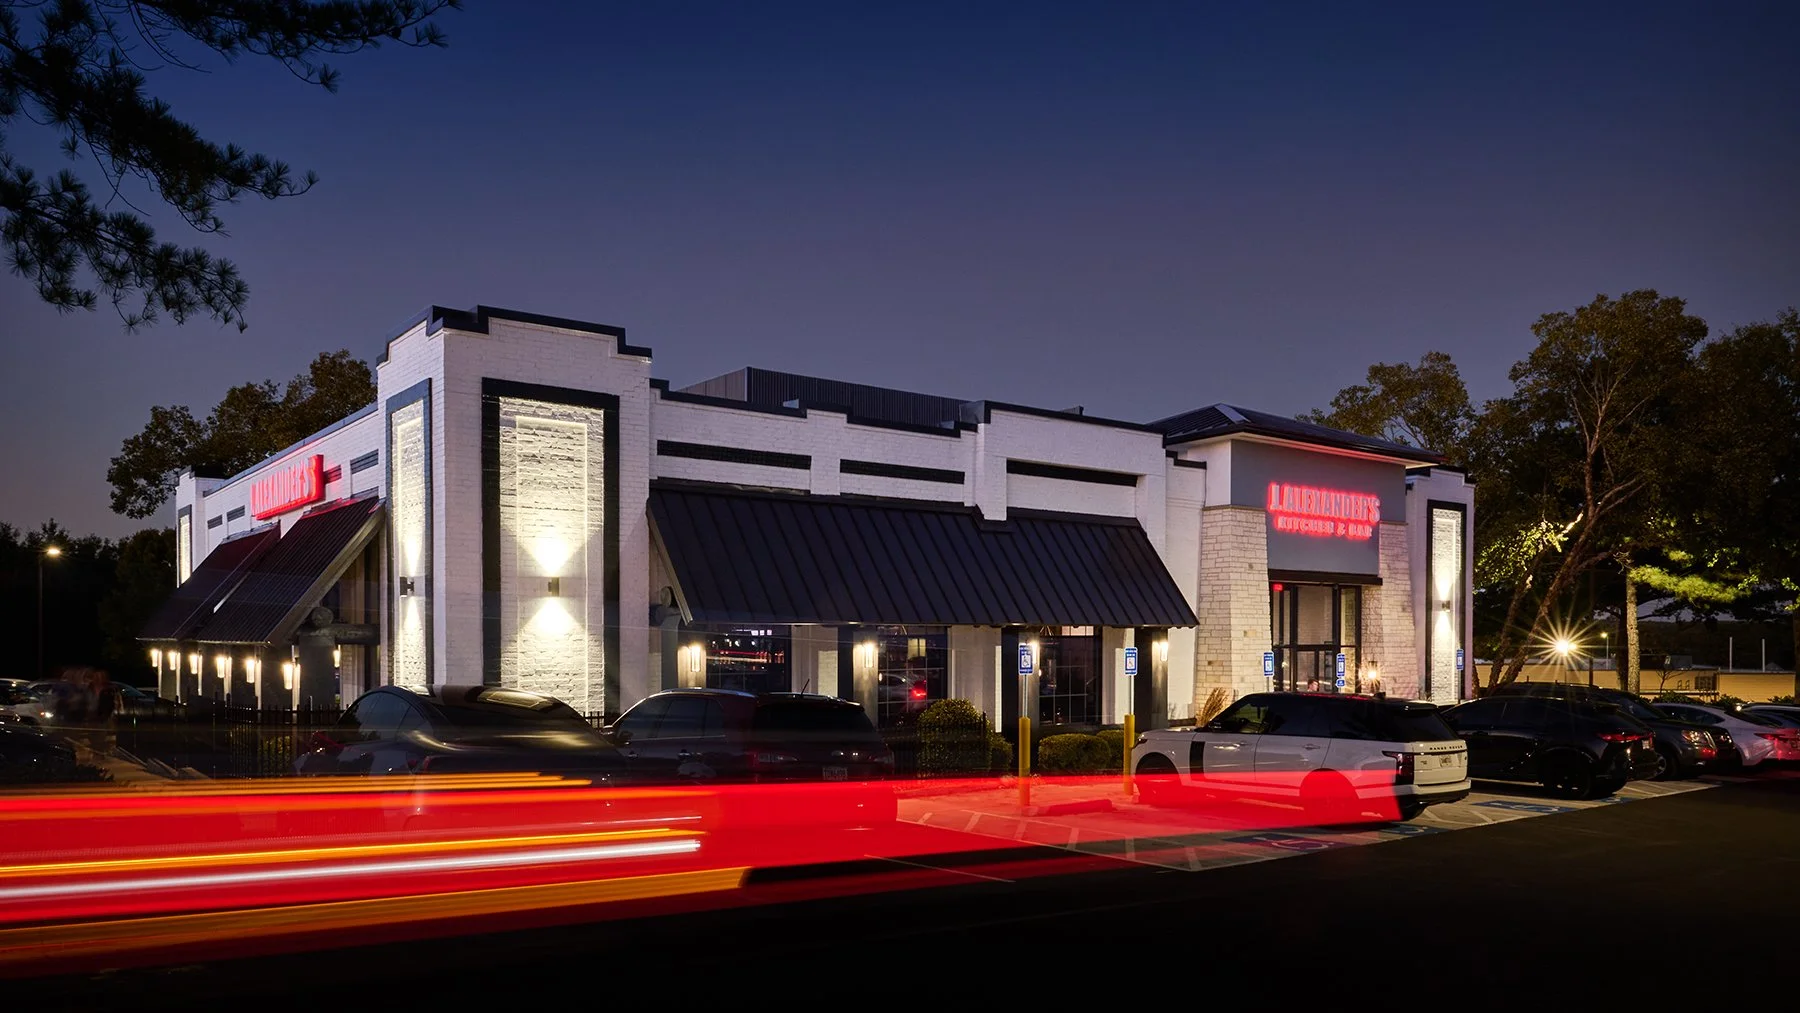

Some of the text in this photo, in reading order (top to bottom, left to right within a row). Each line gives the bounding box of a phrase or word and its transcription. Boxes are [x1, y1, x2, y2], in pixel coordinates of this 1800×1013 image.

[1277, 515, 1372, 538] KITCHEN & BAR
